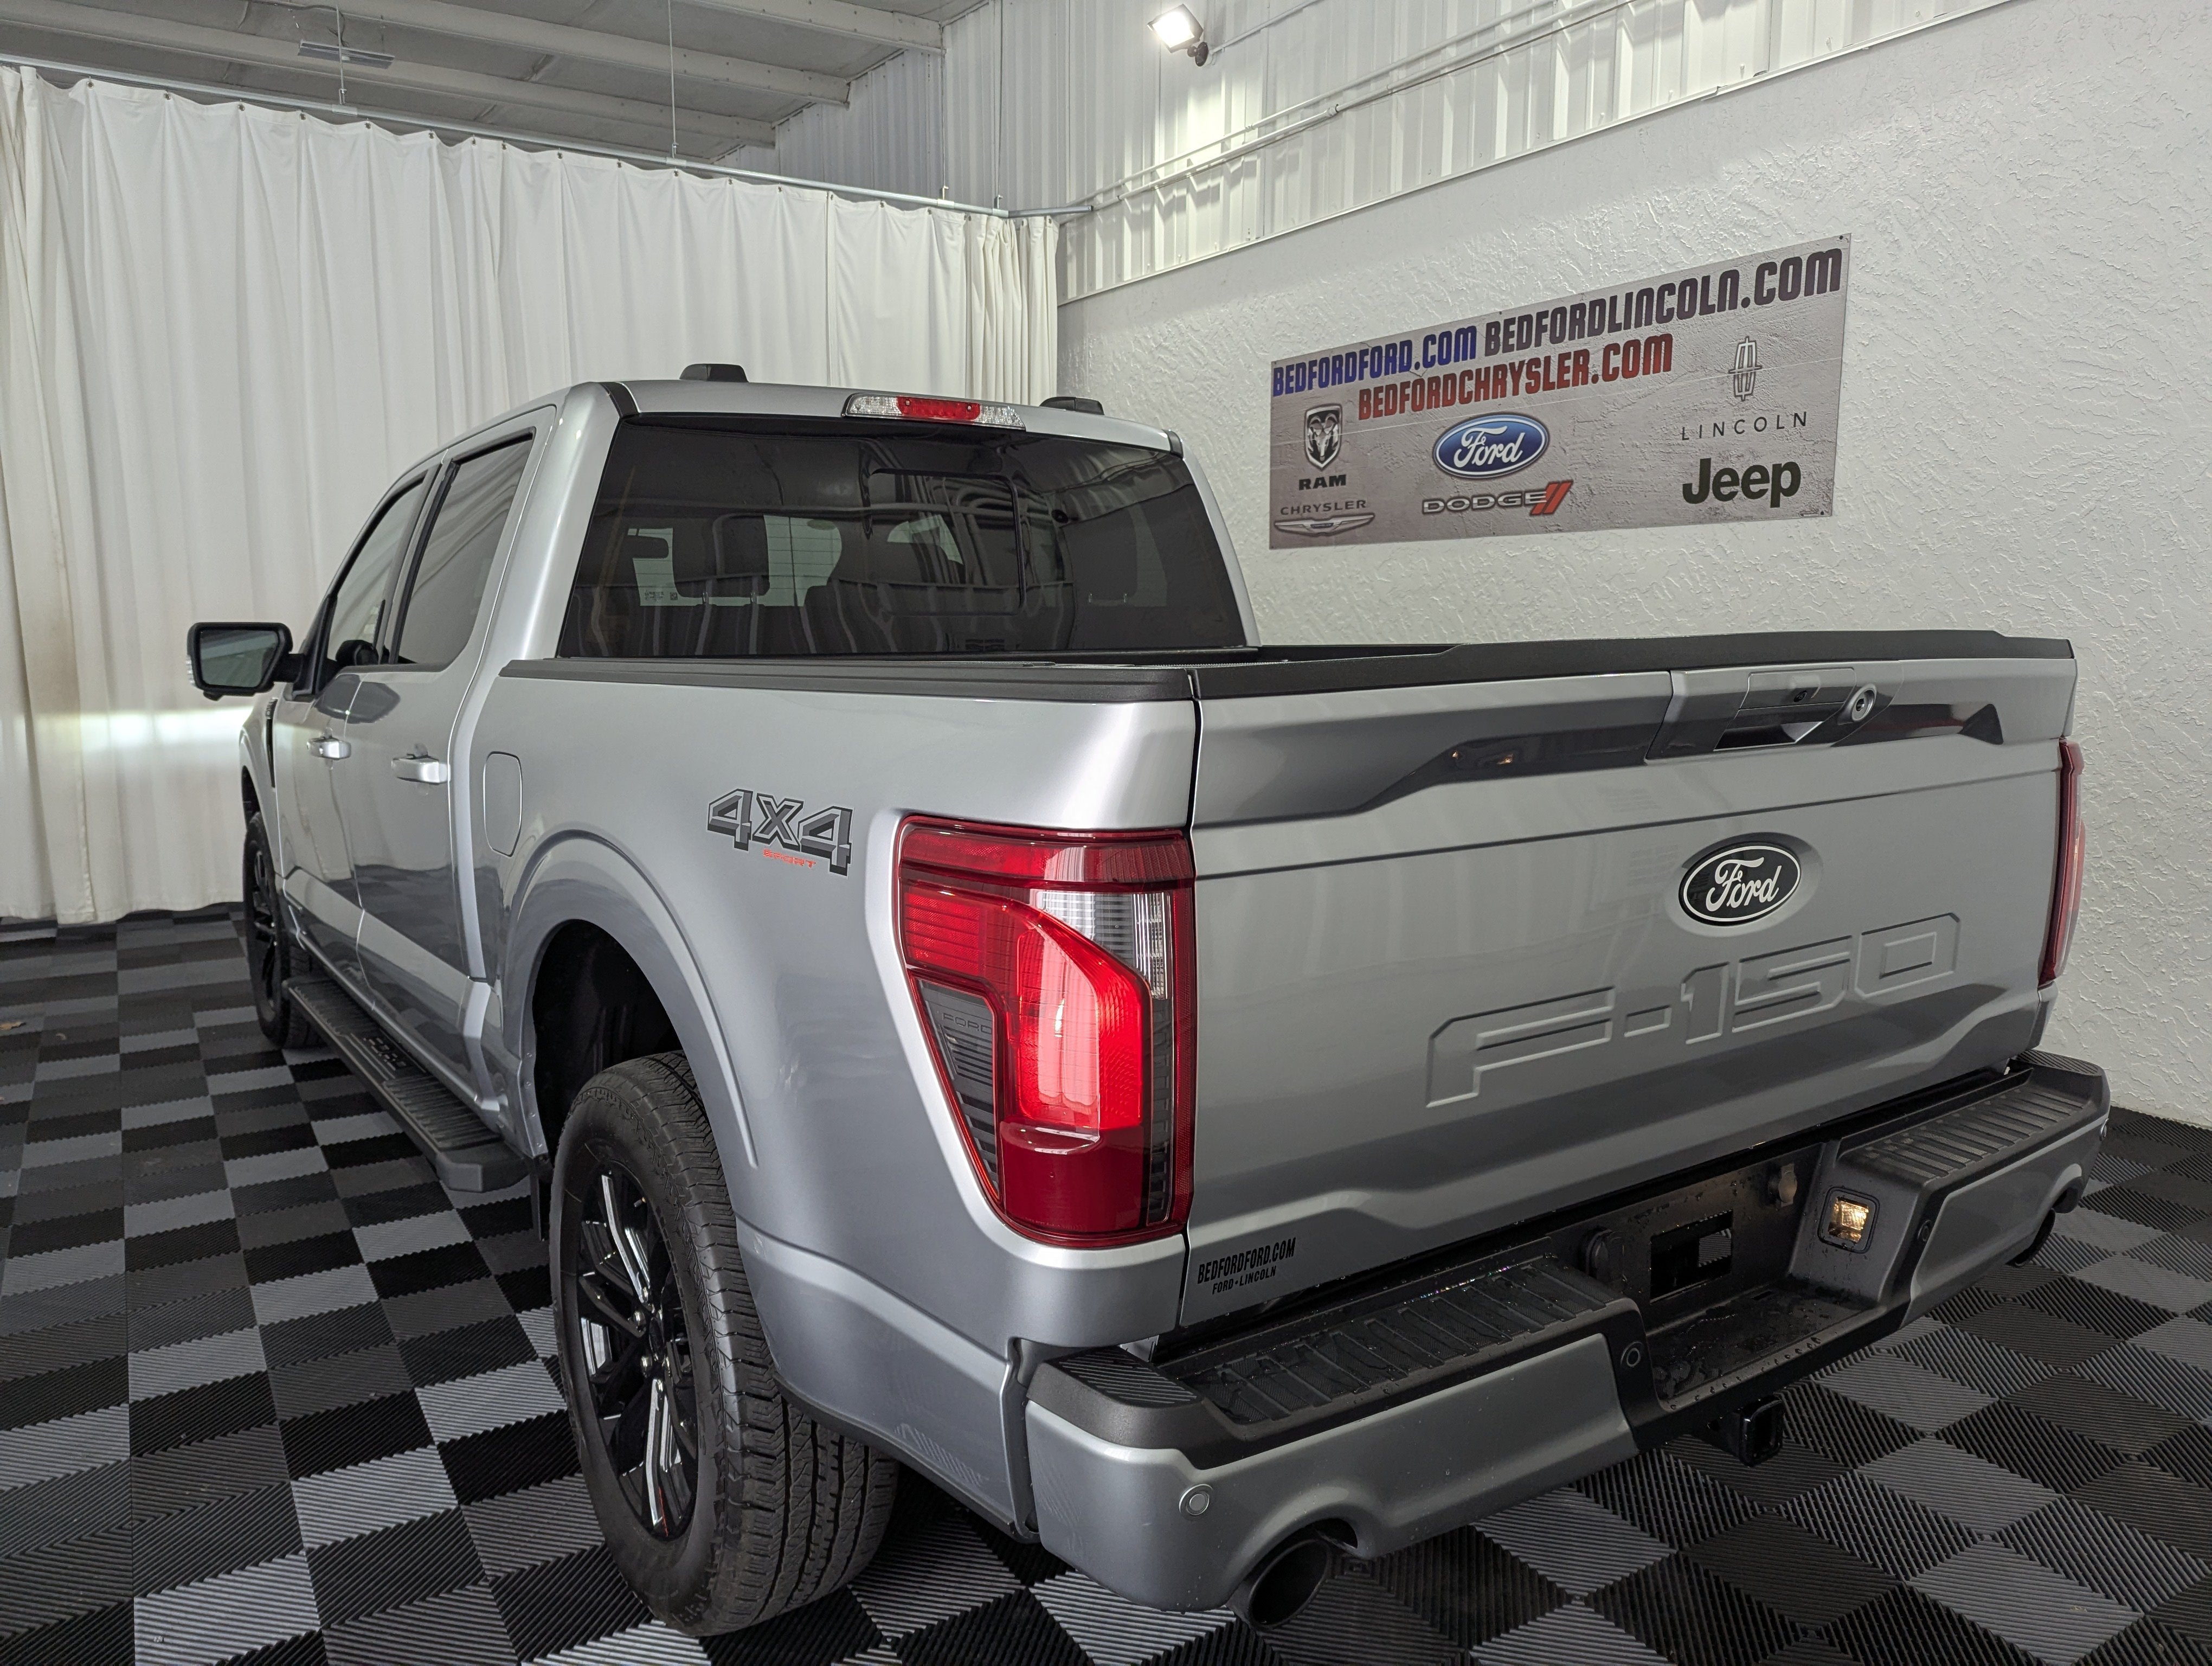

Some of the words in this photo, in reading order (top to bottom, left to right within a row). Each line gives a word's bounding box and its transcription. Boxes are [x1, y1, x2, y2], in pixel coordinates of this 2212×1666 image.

[1272, 325, 1477, 397] BEDFORDFORD.COM
[1484, 248, 1843, 357] BEDFORDLINCOLN.COM
[1358, 332, 1673, 421] BEDFORDCHRYSLER.COM
[1453, 425, 1526, 468] Ford
[1681, 411, 1807, 441] LINCOLN
[1298, 474, 1347, 491] RAM
[1422, 489, 1548, 515] DODGE
[1682, 457, 1802, 509] Jeep
[1280, 499, 1366, 516] CHRYSLER
[1705, 856, 1782, 912] Ford
[942, 1012, 993, 1035] FORD
[1426, 912, 1960, 1108] F-150
[1197, 1236, 1296, 1284] BEDFORDFORD.COM
